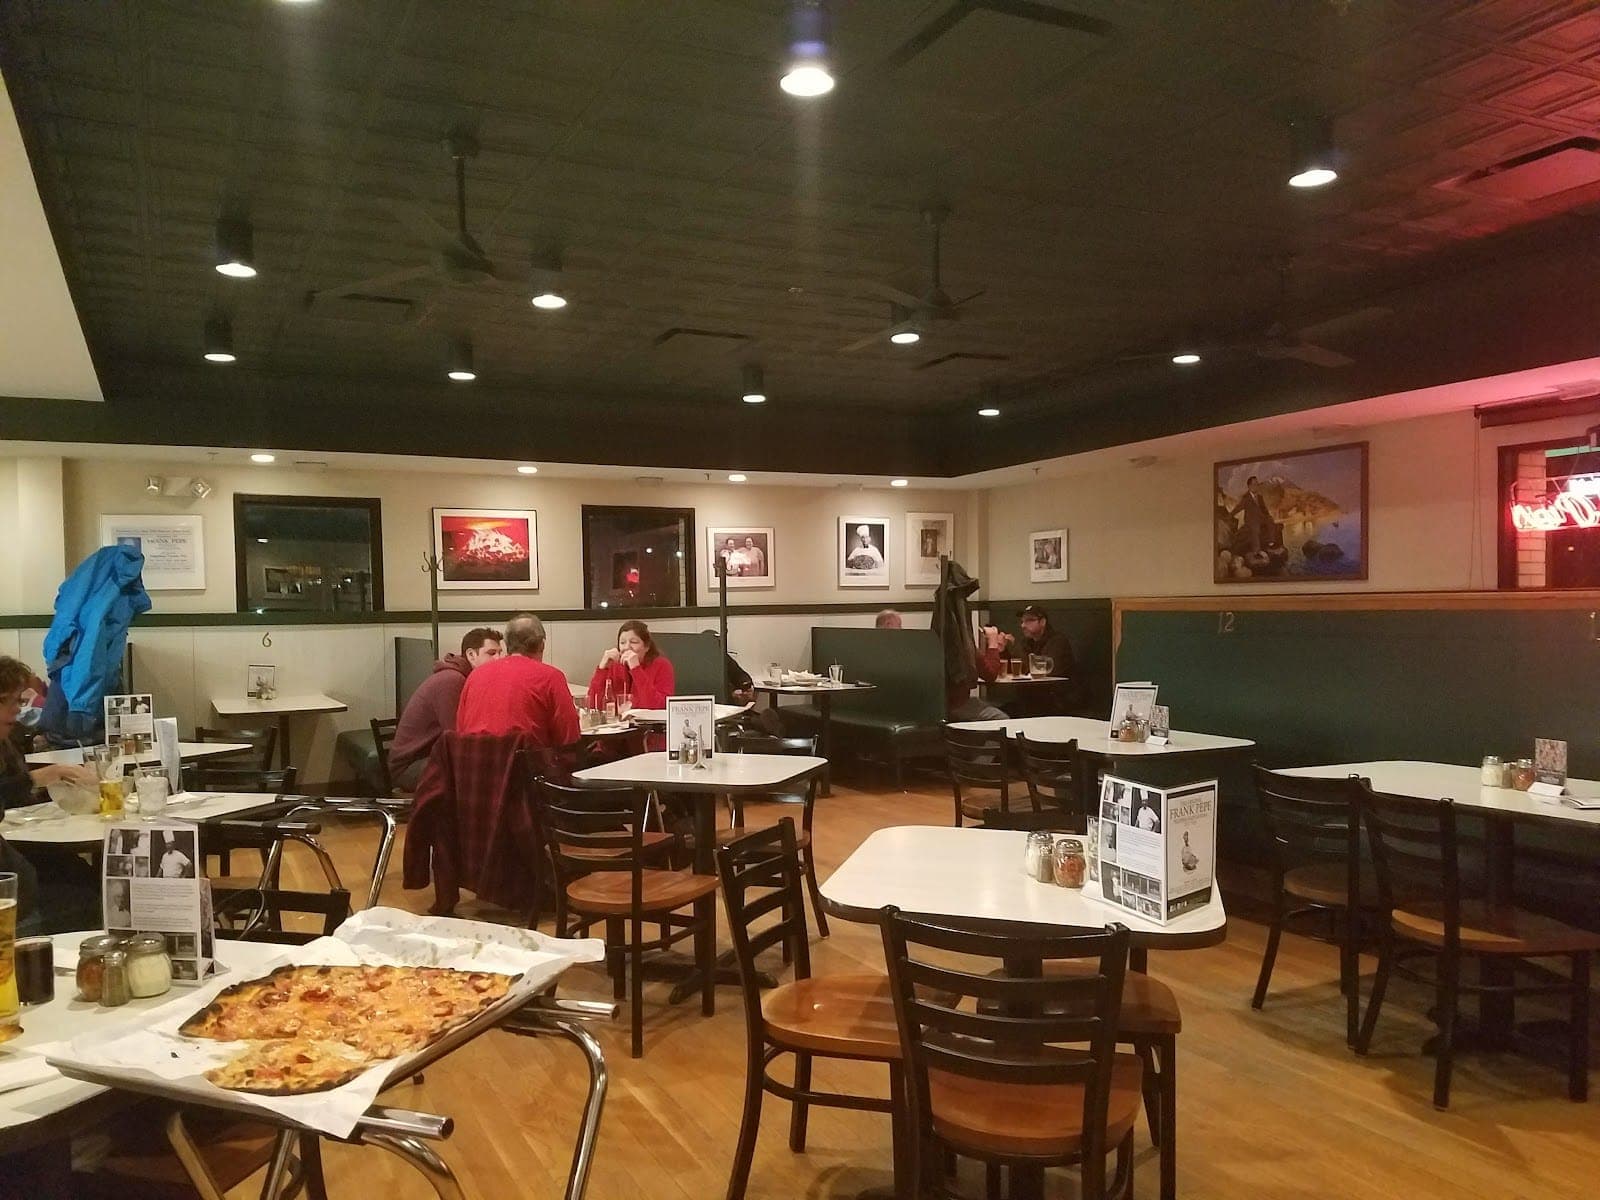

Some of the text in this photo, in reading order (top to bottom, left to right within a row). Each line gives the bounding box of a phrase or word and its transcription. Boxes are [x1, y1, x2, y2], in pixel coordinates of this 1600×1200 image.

[1217, 611, 1235, 633] 12
[262, 632, 272, 647] 6
[1169, 803, 1195, 819] FRANK
[1195, 800, 1213, 815] PEPE
